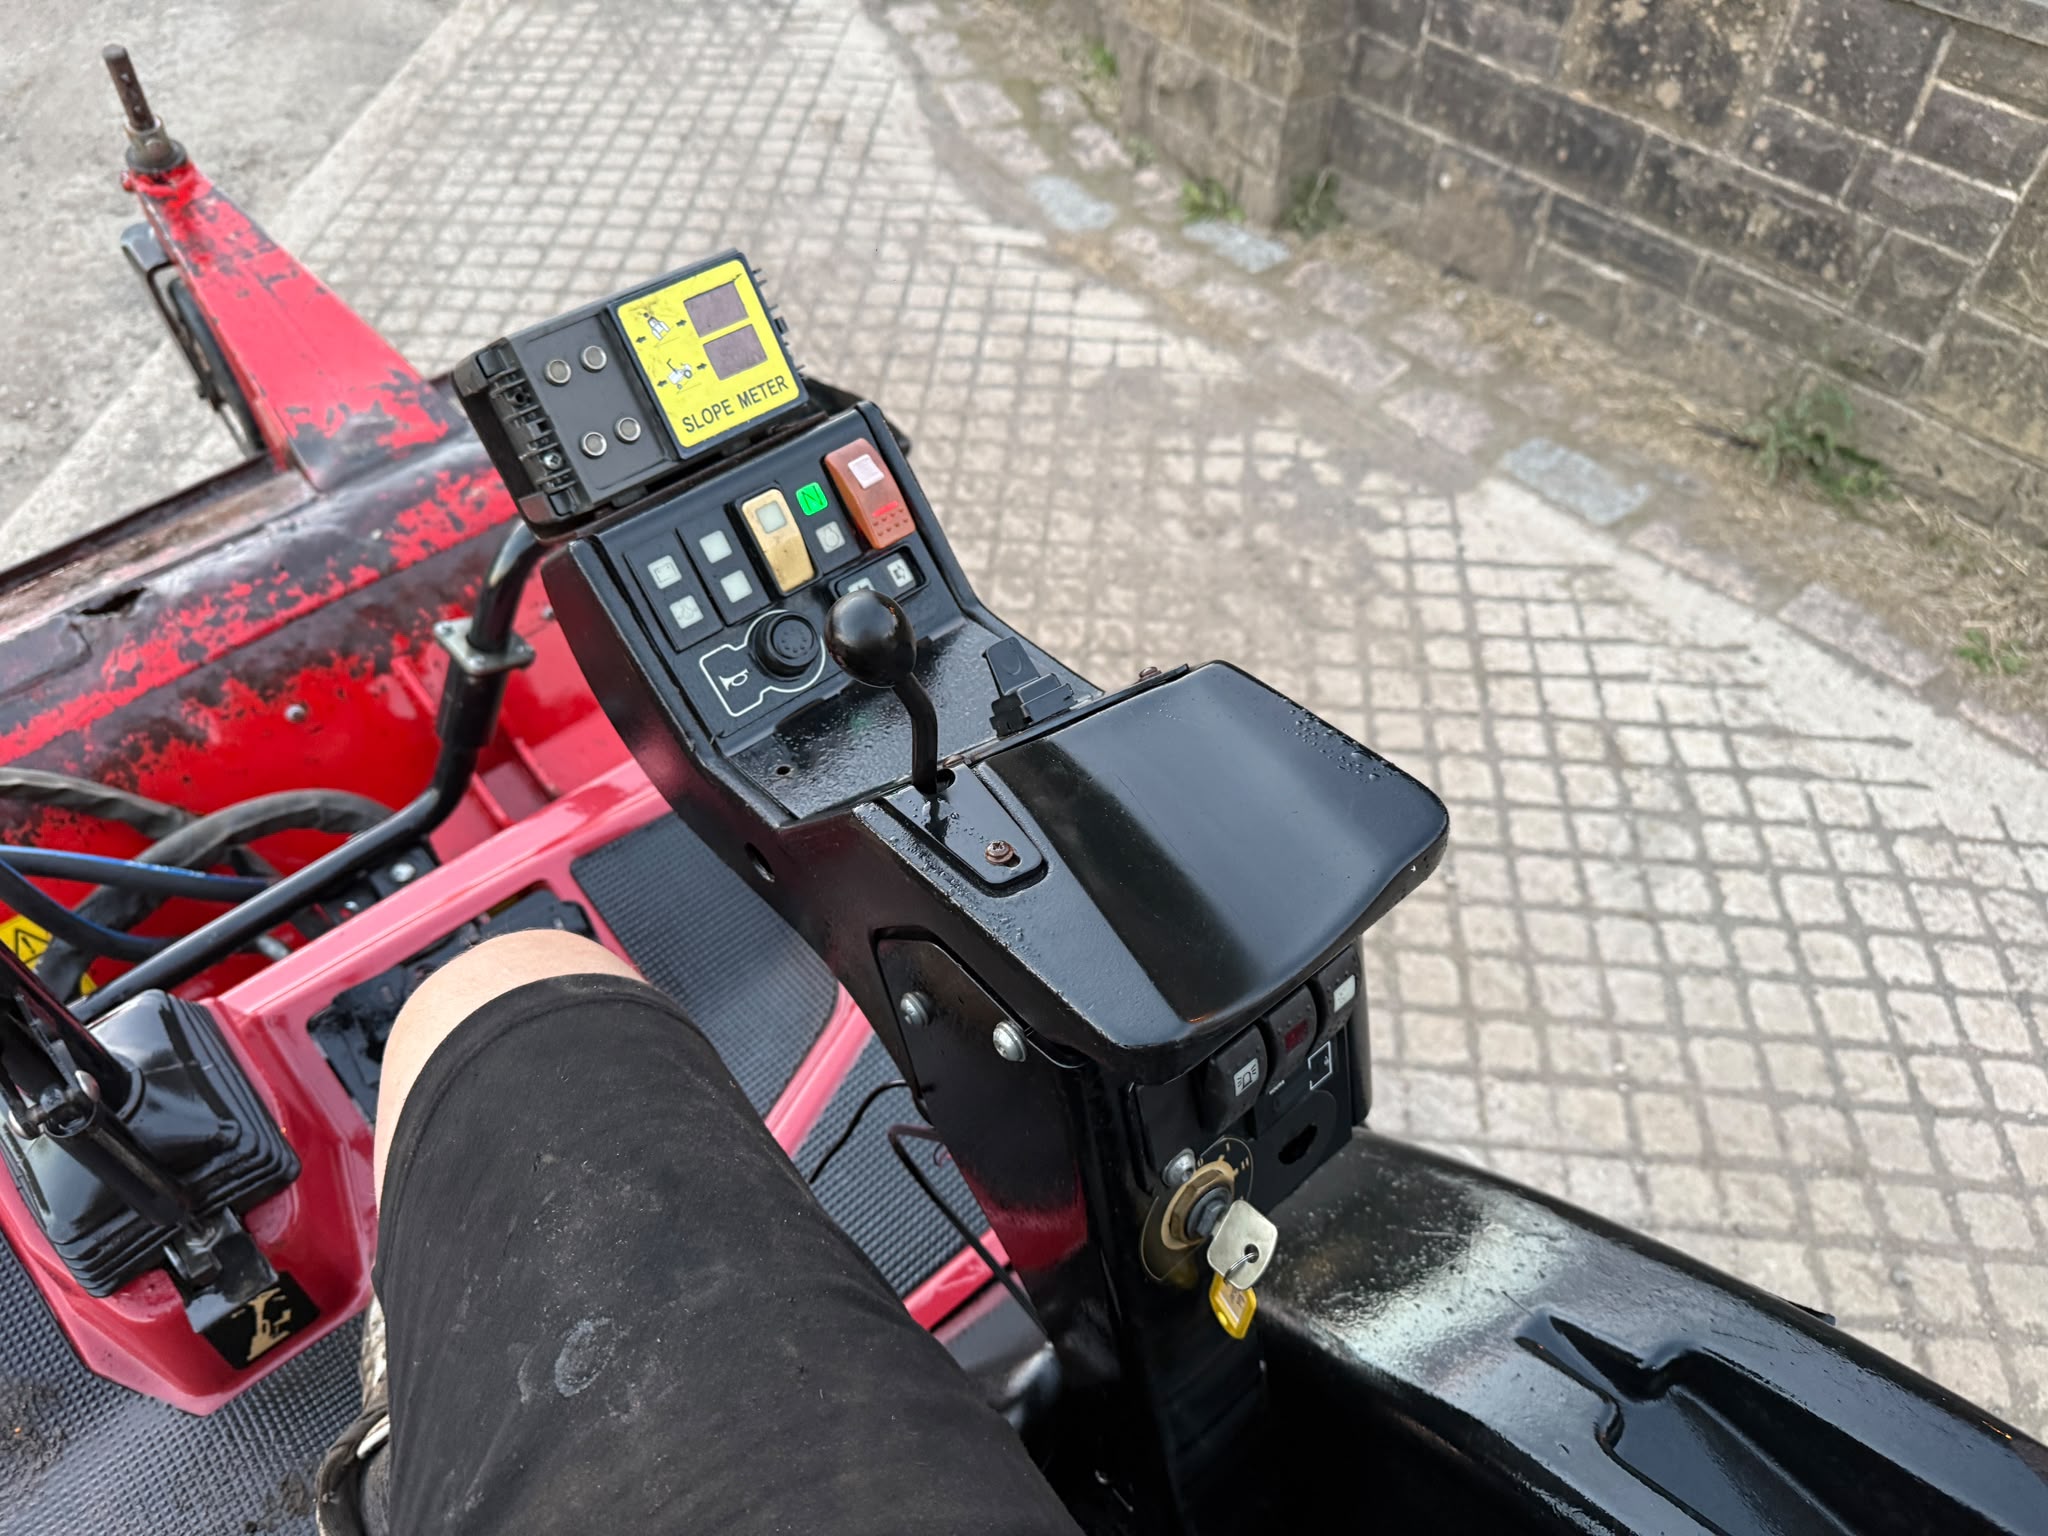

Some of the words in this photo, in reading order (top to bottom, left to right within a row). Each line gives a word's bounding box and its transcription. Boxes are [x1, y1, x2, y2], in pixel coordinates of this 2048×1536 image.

[682, 398, 735, 433] SLOPE
[736, 375, 789, 409] METER
[801, 485, 824, 512] N
